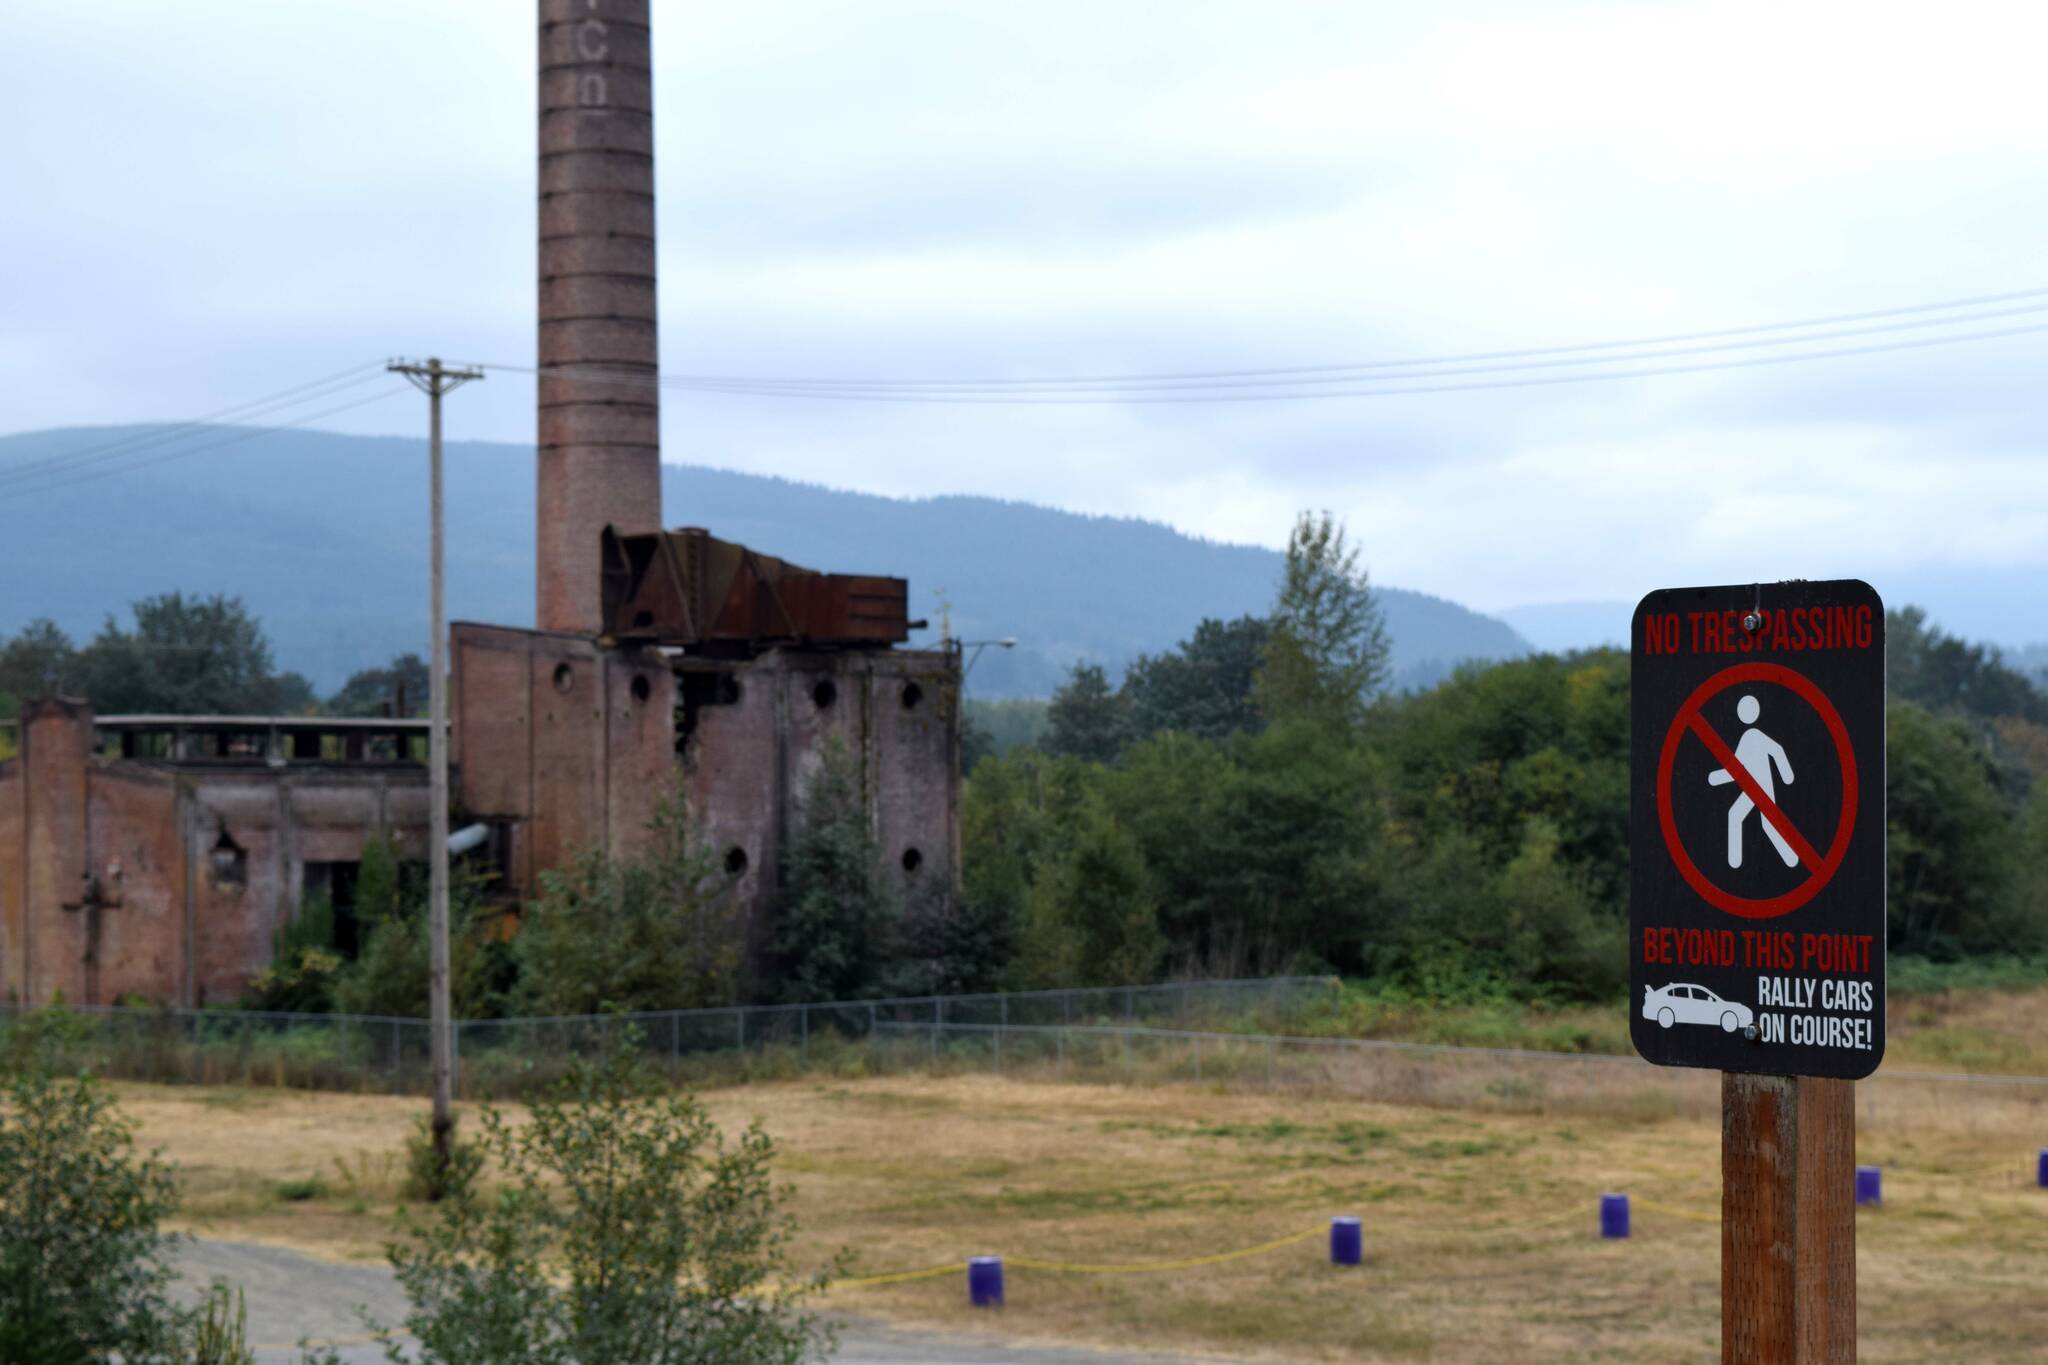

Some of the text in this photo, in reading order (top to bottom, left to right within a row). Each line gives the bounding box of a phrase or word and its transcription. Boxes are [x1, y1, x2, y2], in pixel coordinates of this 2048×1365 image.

[1645, 604, 1873, 655] NO TRESPASSING
[1643, 927, 1873, 973] BEYOND THIS POINT
[1758, 976, 1873, 1012] RALLY CARS
[1759, 1013, 1873, 1050] ON COURSE!
